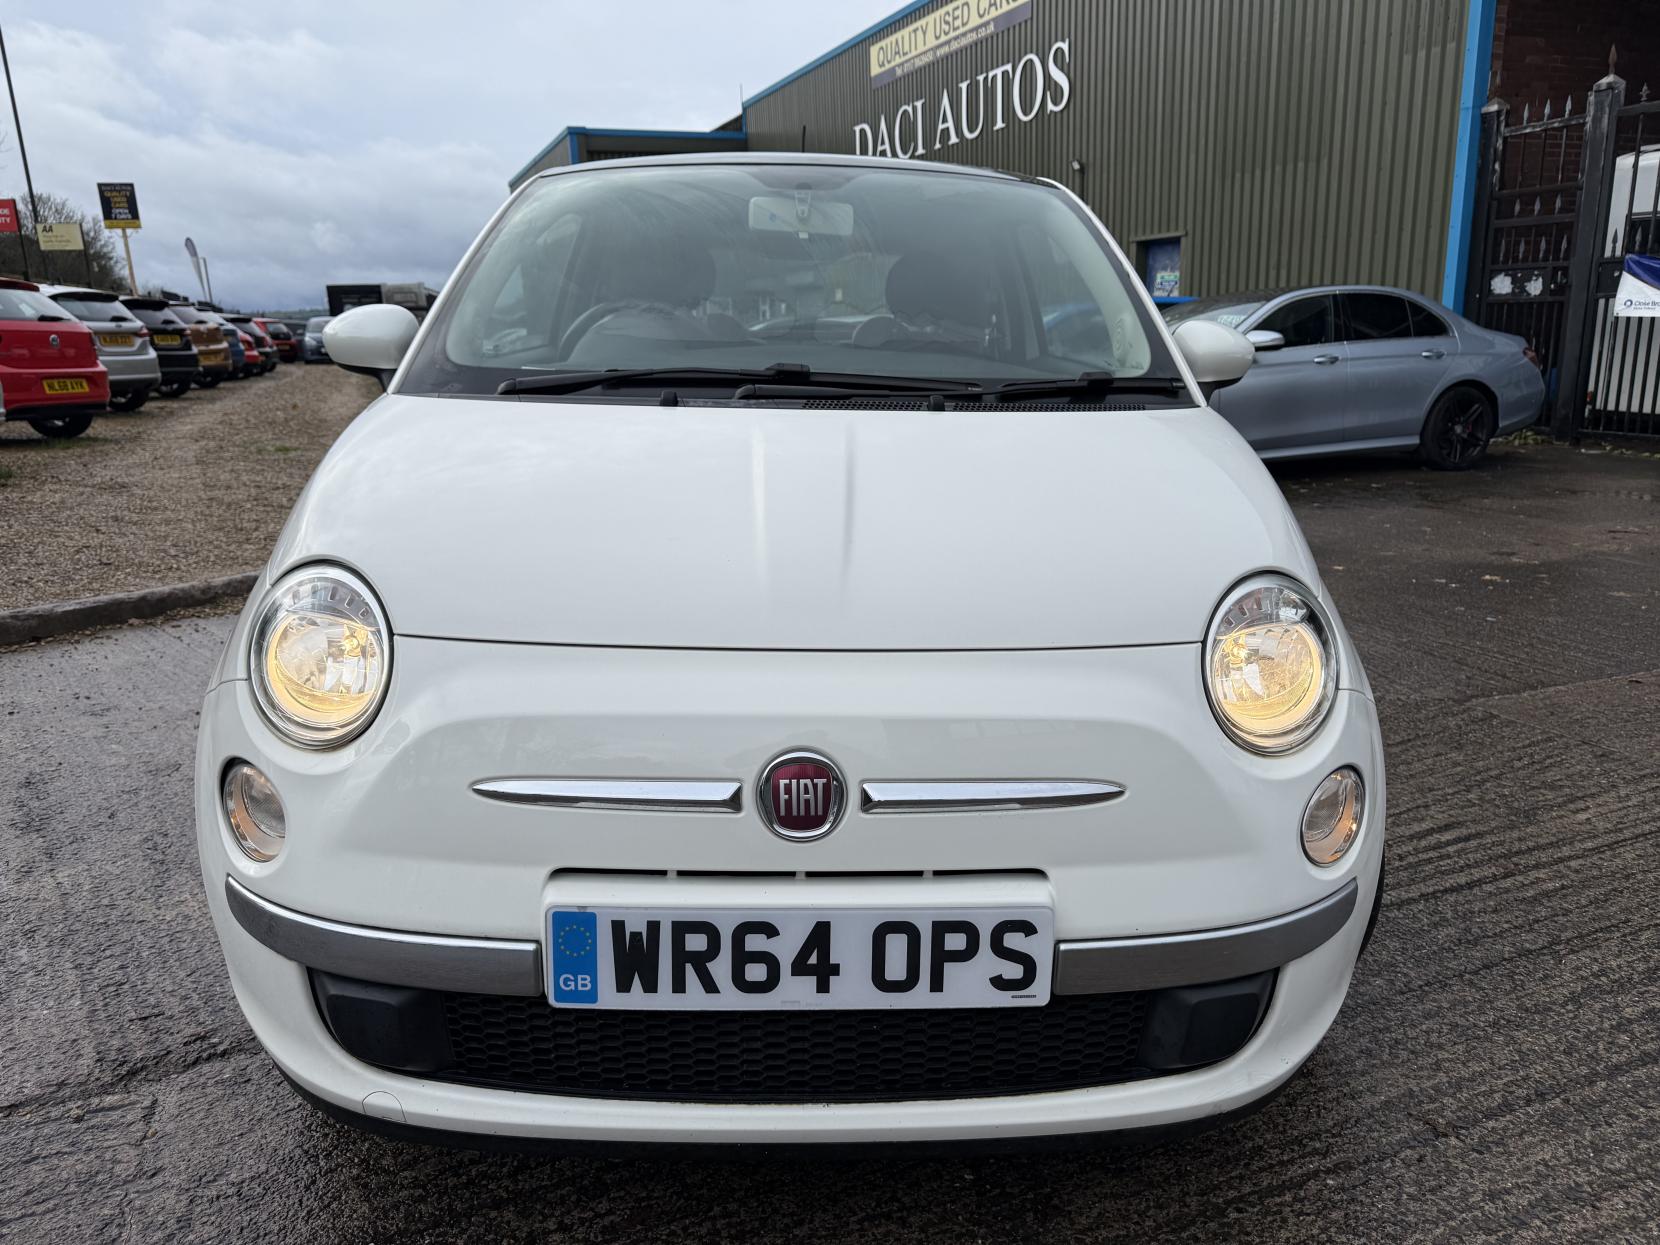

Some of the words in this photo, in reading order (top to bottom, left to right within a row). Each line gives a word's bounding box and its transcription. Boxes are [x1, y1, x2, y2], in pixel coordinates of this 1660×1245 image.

[877, 22, 929, 68] QUALITY
[933, 2, 970, 41] USED
[976, 0, 1018, 18] CA
[853, 98, 926, 158] DACI
[933, 38, 1070, 150] AUTOS
[42, 225, 54, 233] AA
[779, 778, 827, 817] FIAT
[559, 973, 592, 992] GB
[610, 919, 841, 994] WR64
[871, 919, 1039, 994] OPS
